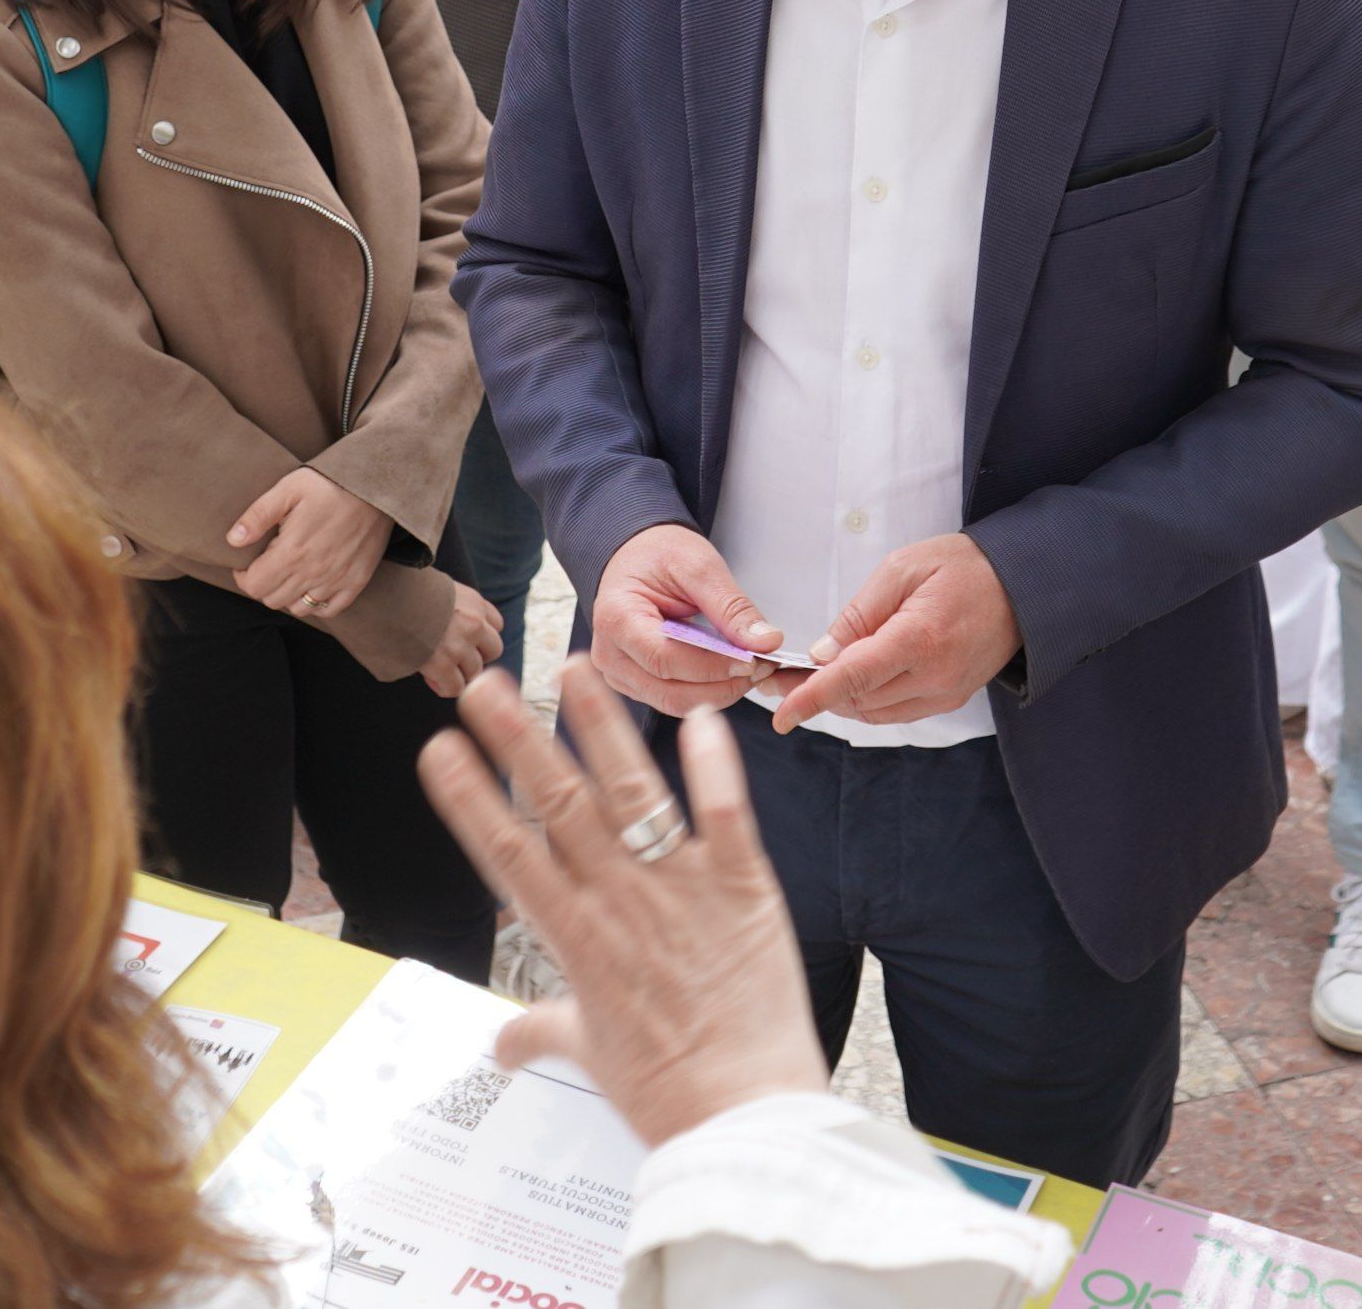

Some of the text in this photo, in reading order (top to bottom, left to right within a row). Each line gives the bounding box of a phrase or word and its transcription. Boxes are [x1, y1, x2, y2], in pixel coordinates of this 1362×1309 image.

[429, 1134, 469, 1154] TODO
[362, 1228, 397, 1247] Josep
[399, 1242, 420, 1256] IES
